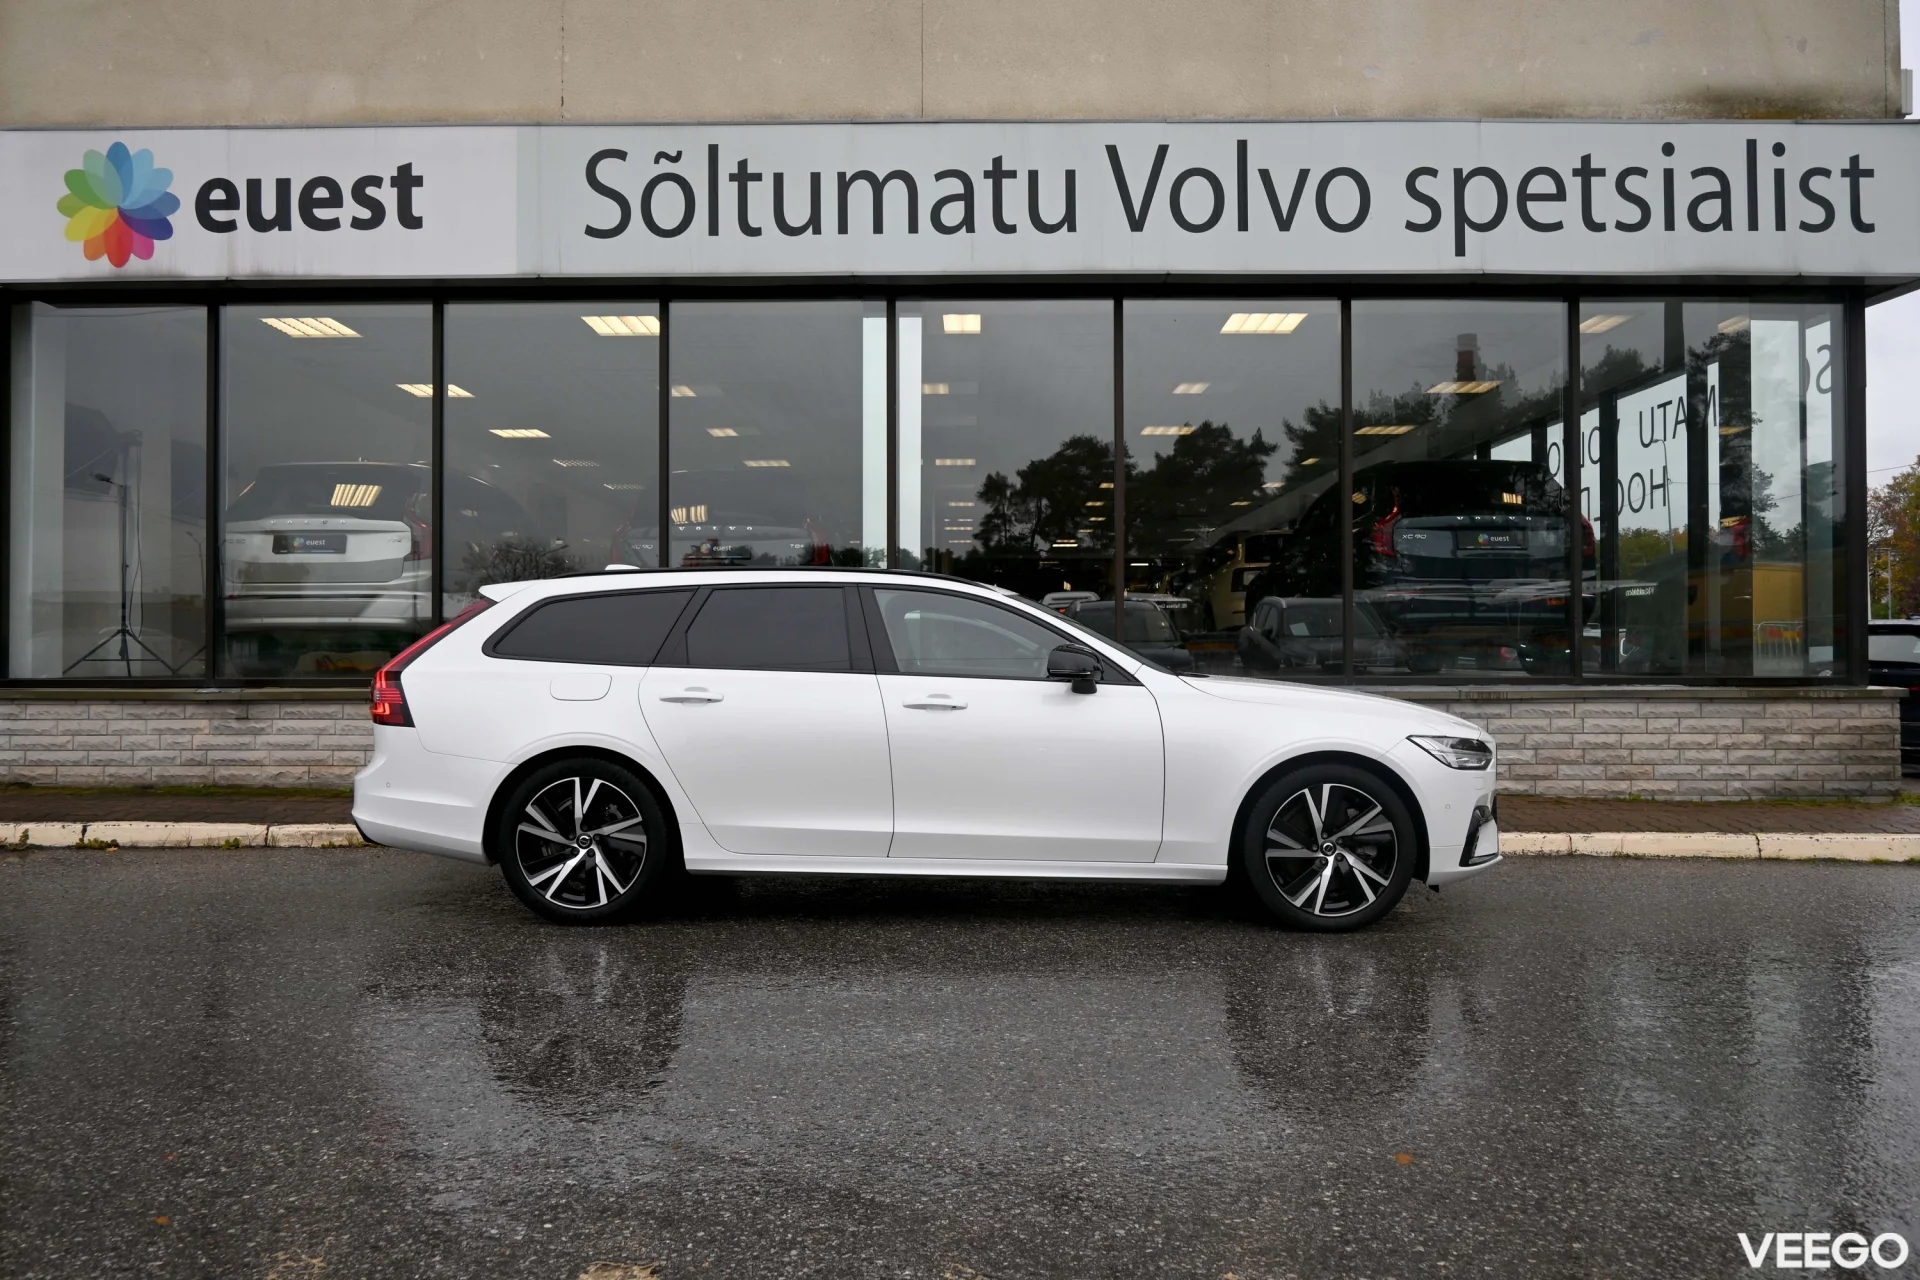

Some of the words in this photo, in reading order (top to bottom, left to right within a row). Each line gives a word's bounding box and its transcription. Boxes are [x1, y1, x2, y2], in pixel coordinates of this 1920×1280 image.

[195, 162, 424, 233] euest
[585, 143, 1077, 239] Sõltumatu
[1105, 139, 1371, 233] Volvo
[1404, 138, 1876, 257] spetsialist
[712, 544, 732, 552] euest
